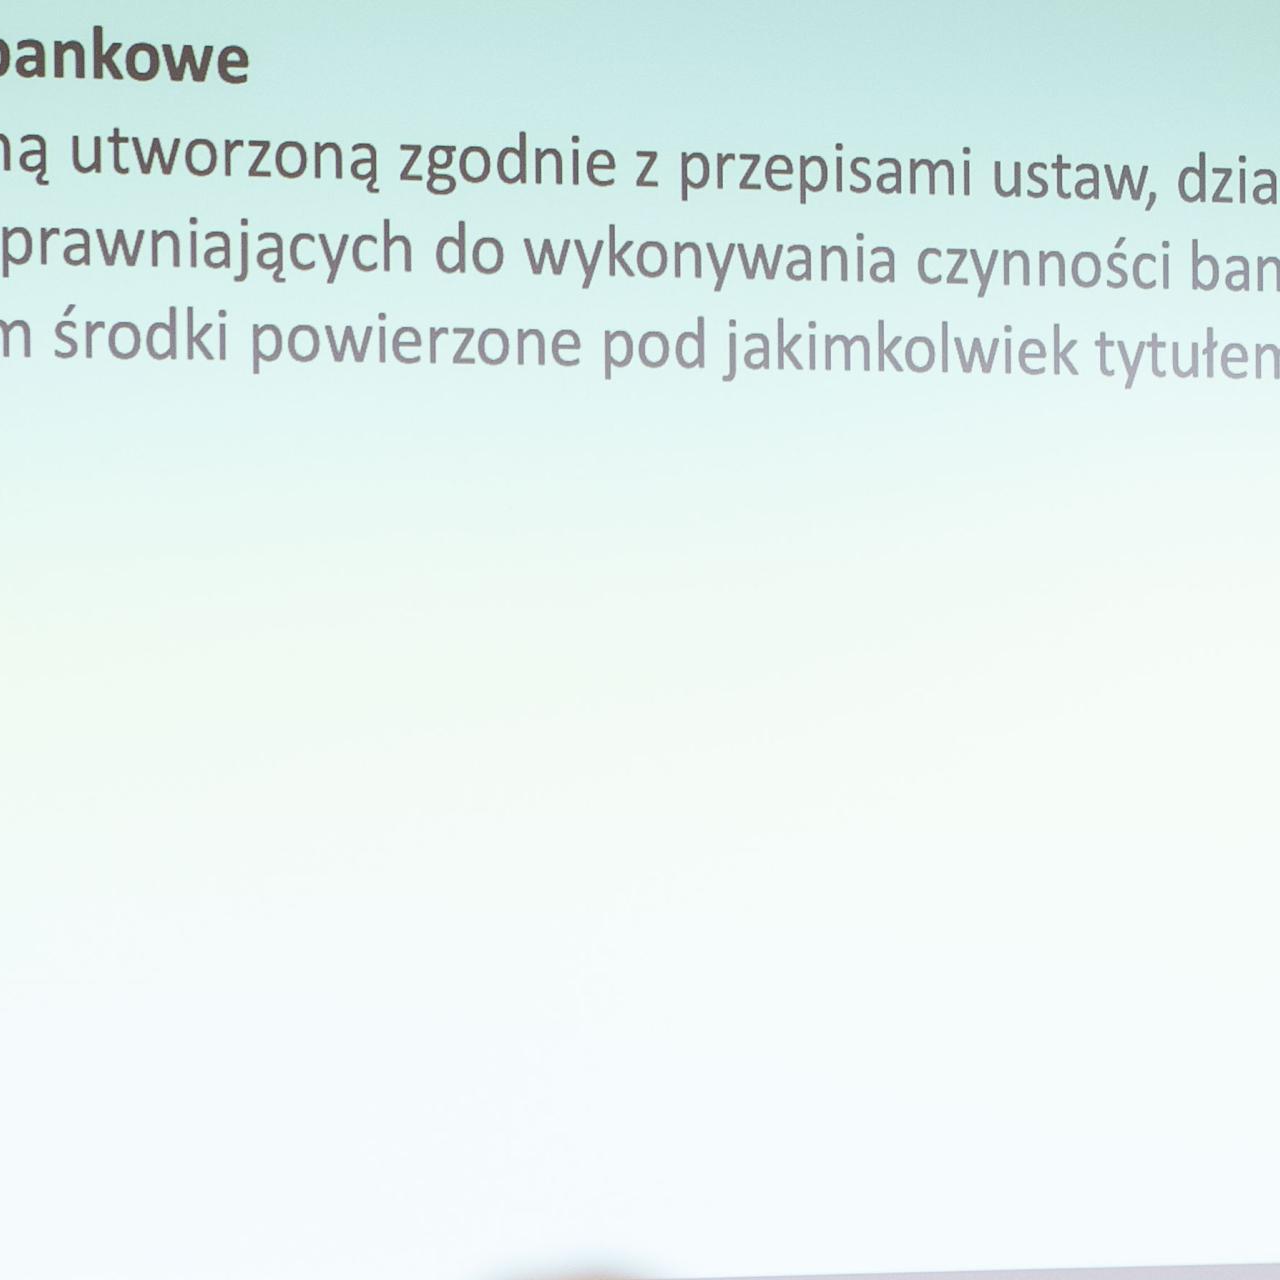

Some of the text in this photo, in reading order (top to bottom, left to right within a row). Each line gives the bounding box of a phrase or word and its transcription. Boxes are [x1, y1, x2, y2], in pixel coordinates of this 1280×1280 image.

[71, 126, 381, 195] utworzoną
[399, 130, 617, 196] zgodnie
[635, 149, 660, 188] z
[680, 142, 972, 206] przepisami
[993, 153, 1158, 212] ustaw,
[435, 219, 505, 276] do
[522, 223, 896, 293] wykonywania
[917, 236, 1171, 299] czynności
[53, 303, 228, 361] środki
[252, 311, 582, 375] powierzone
[604, 315, 706, 381] pod
[721, 316, 1080, 383] jakimkolwiek
